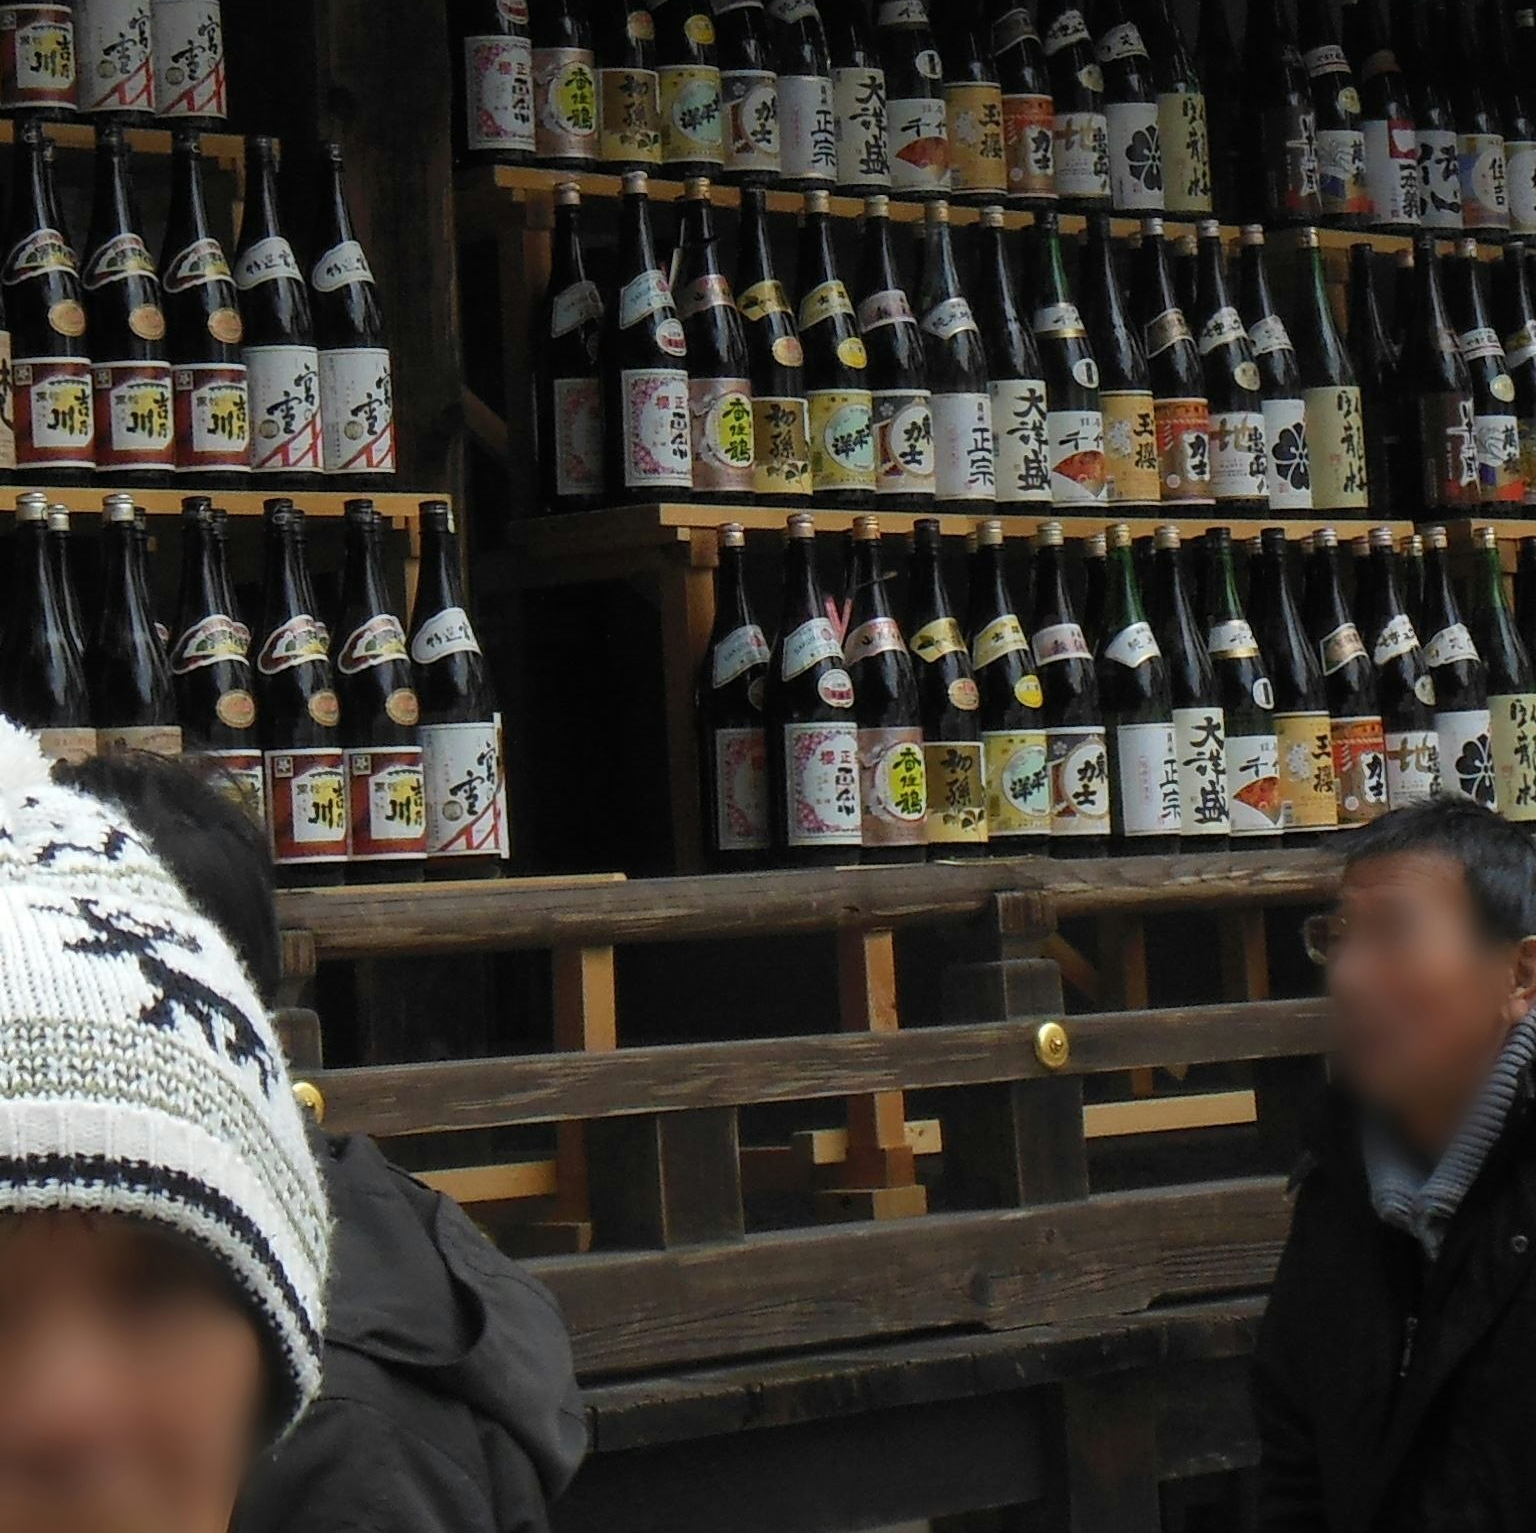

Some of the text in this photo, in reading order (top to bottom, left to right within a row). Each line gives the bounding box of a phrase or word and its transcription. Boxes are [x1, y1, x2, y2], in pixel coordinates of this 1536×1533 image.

[726, 397, 750, 462] 香住鶴
[893, 748, 923, 816] 香住鶴
